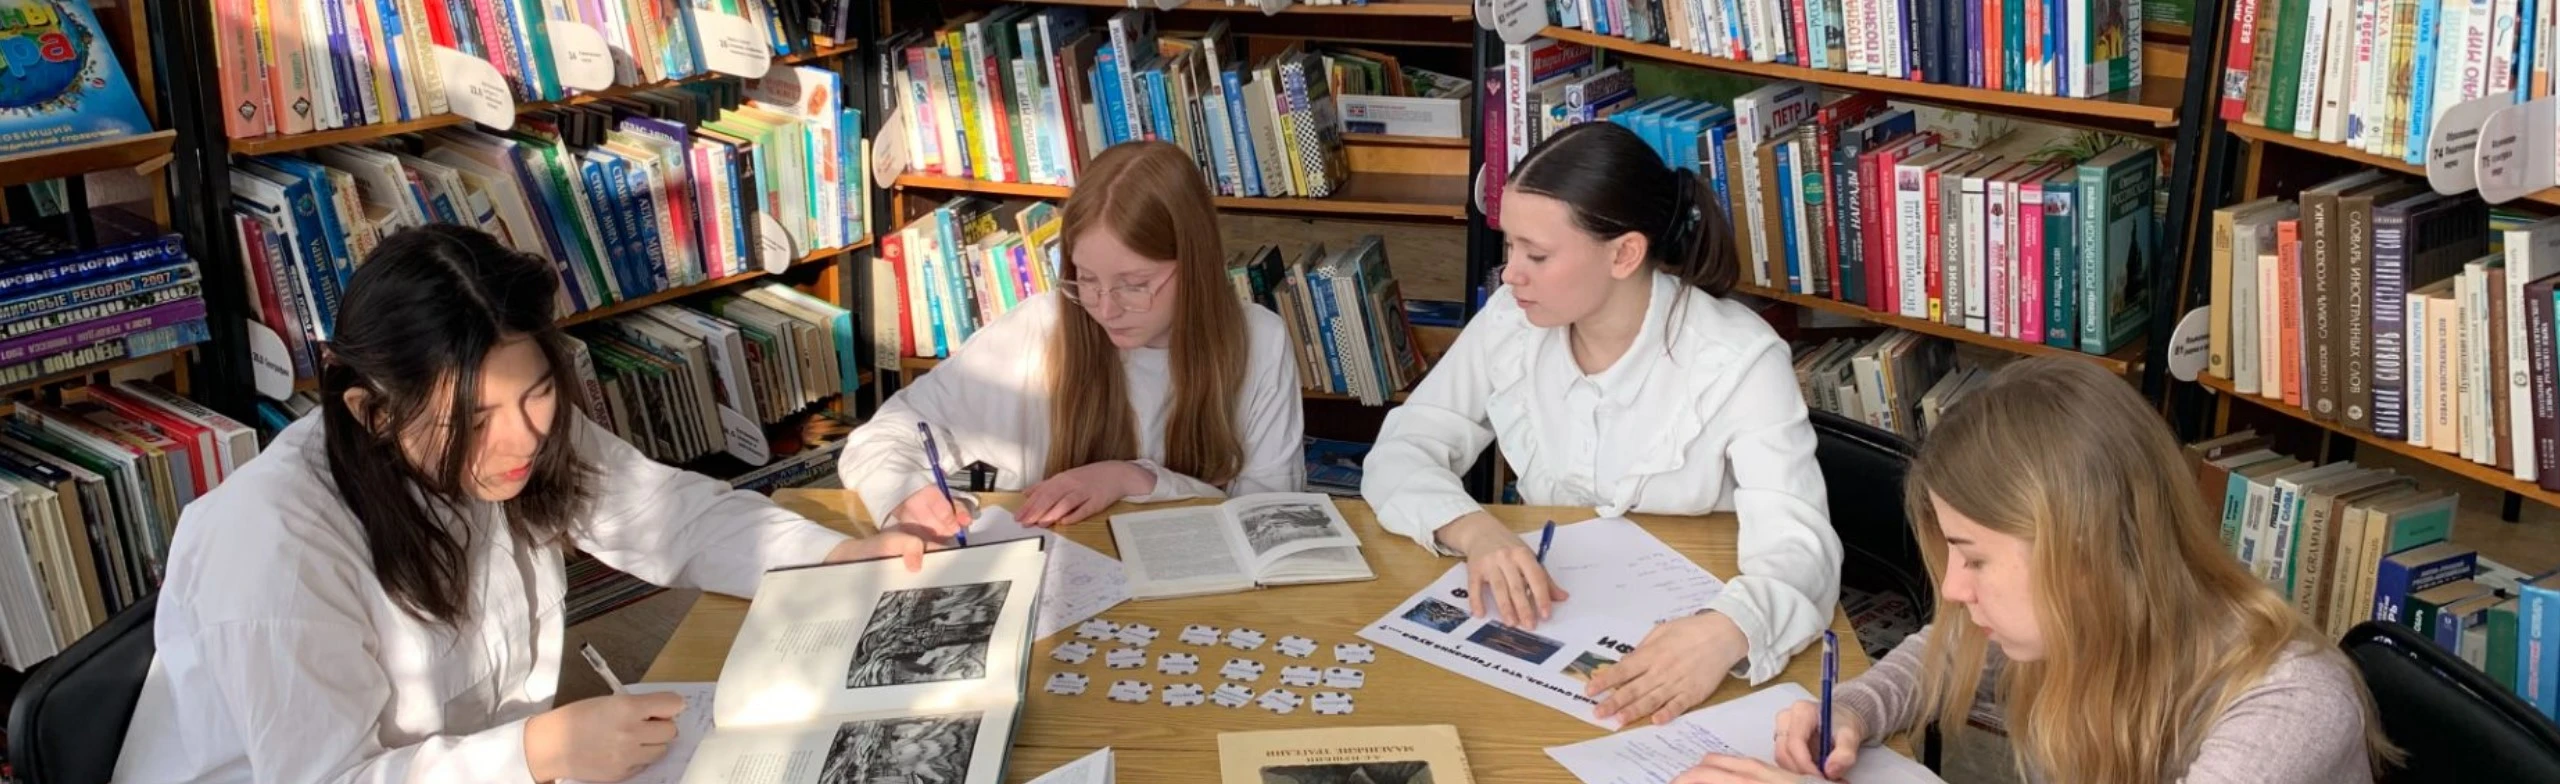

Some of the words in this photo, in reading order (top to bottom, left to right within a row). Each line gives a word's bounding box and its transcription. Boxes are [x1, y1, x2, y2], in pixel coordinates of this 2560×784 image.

[1864, 0, 1878, 49] ПОЗНА
[2360, 11, 2374, 62] РОССИИ
[2378, 0, 2391, 37] УКА
[2421, 8, 2432, 43] НАУКА
[0, 32, 77, 78] ра
[1866, 53, 1877, 64] Я
[2469, 26, 2485, 60] МИР
[1509, 64, 1521, 106] РОССИИ
[2495, 55, 2509, 90] МИР
[1772, 100, 1804, 130] ПЕТР
[2412, 54, 2427, 139] ЭНЦИКЛОПЕДИЯ
[0, 125, 73, 141] ОВЕЙШИЙ
[1511, 101, 1525, 147] История
[590, 172, 609, 213] СТРАНЫ
[602, 215, 619, 245] МИРА
[612, 165, 632, 209] СТРАНЫ
[623, 209, 638, 240] МИРА
[1836, 174, 1844, 207] РОССИИ
[1846, 169, 1862, 230] НАГРАДЫ
[637, 197, 653, 229] АТЛАС
[647, 235, 663, 271] МИРА
[1837, 209, 1847, 256] ПРАВИТЕЛИ
[1903, 200, 1915, 250] РОССИИ
[2315, 203, 2324, 237] ЯЗЫКА
[2351, 211, 2361, 262] СЛОВАРЬ
[2375, 229, 2400, 249] СЛОВ
[310, 238, 327, 273] МИРА
[1949, 222, 1958, 261] РОССИИ
[2084, 220, 2097, 289] РОССИЙСКОЙ
[0, 271, 58, 289] ИРОВЫЕ
[60, 253, 129, 275] РЕКОРДЫ
[1905, 254, 1918, 312] ИСТОРИЯ
[2316, 240, 2326, 292] РУССКОГО
[0, 297, 67, 319] МИРОВЫЕ
[72, 278, 137, 301] РЕКОРДЫ
[141, 272, 172, 288] 2007
[1949, 265, 1958, 316] ИСТОРИЯ
[7, 316, 54, 336] КНИГА
[58, 299, 125, 325] РЕКОРДОВ
[2318, 295, 2328, 339] СЛОВАРЬ
[2350, 267, 2361, 357] ИНОСТРАННЫХ
[2351, 360, 2360, 393] СЛОВ
[2376, 332, 2401, 381] СЛОВАРЬ
[2439, 338, 2447, 391] ИНОСТРАННЫХ
[2304, 509, 2325, 574] GRAMMAR
[2301, 577, 2318, 615] IONAL
[1401, 632, 1434, 647] душа
[1501, 668, 1522, 679] что
[1525, 676, 1573, 697] считал,
[1571, 693, 1599, 706] кий
[1265, 748, 1332, 758] ТРАГЕДИИ
[1335, 745, 1414, 755] МАЛЕНЬКИЕ
